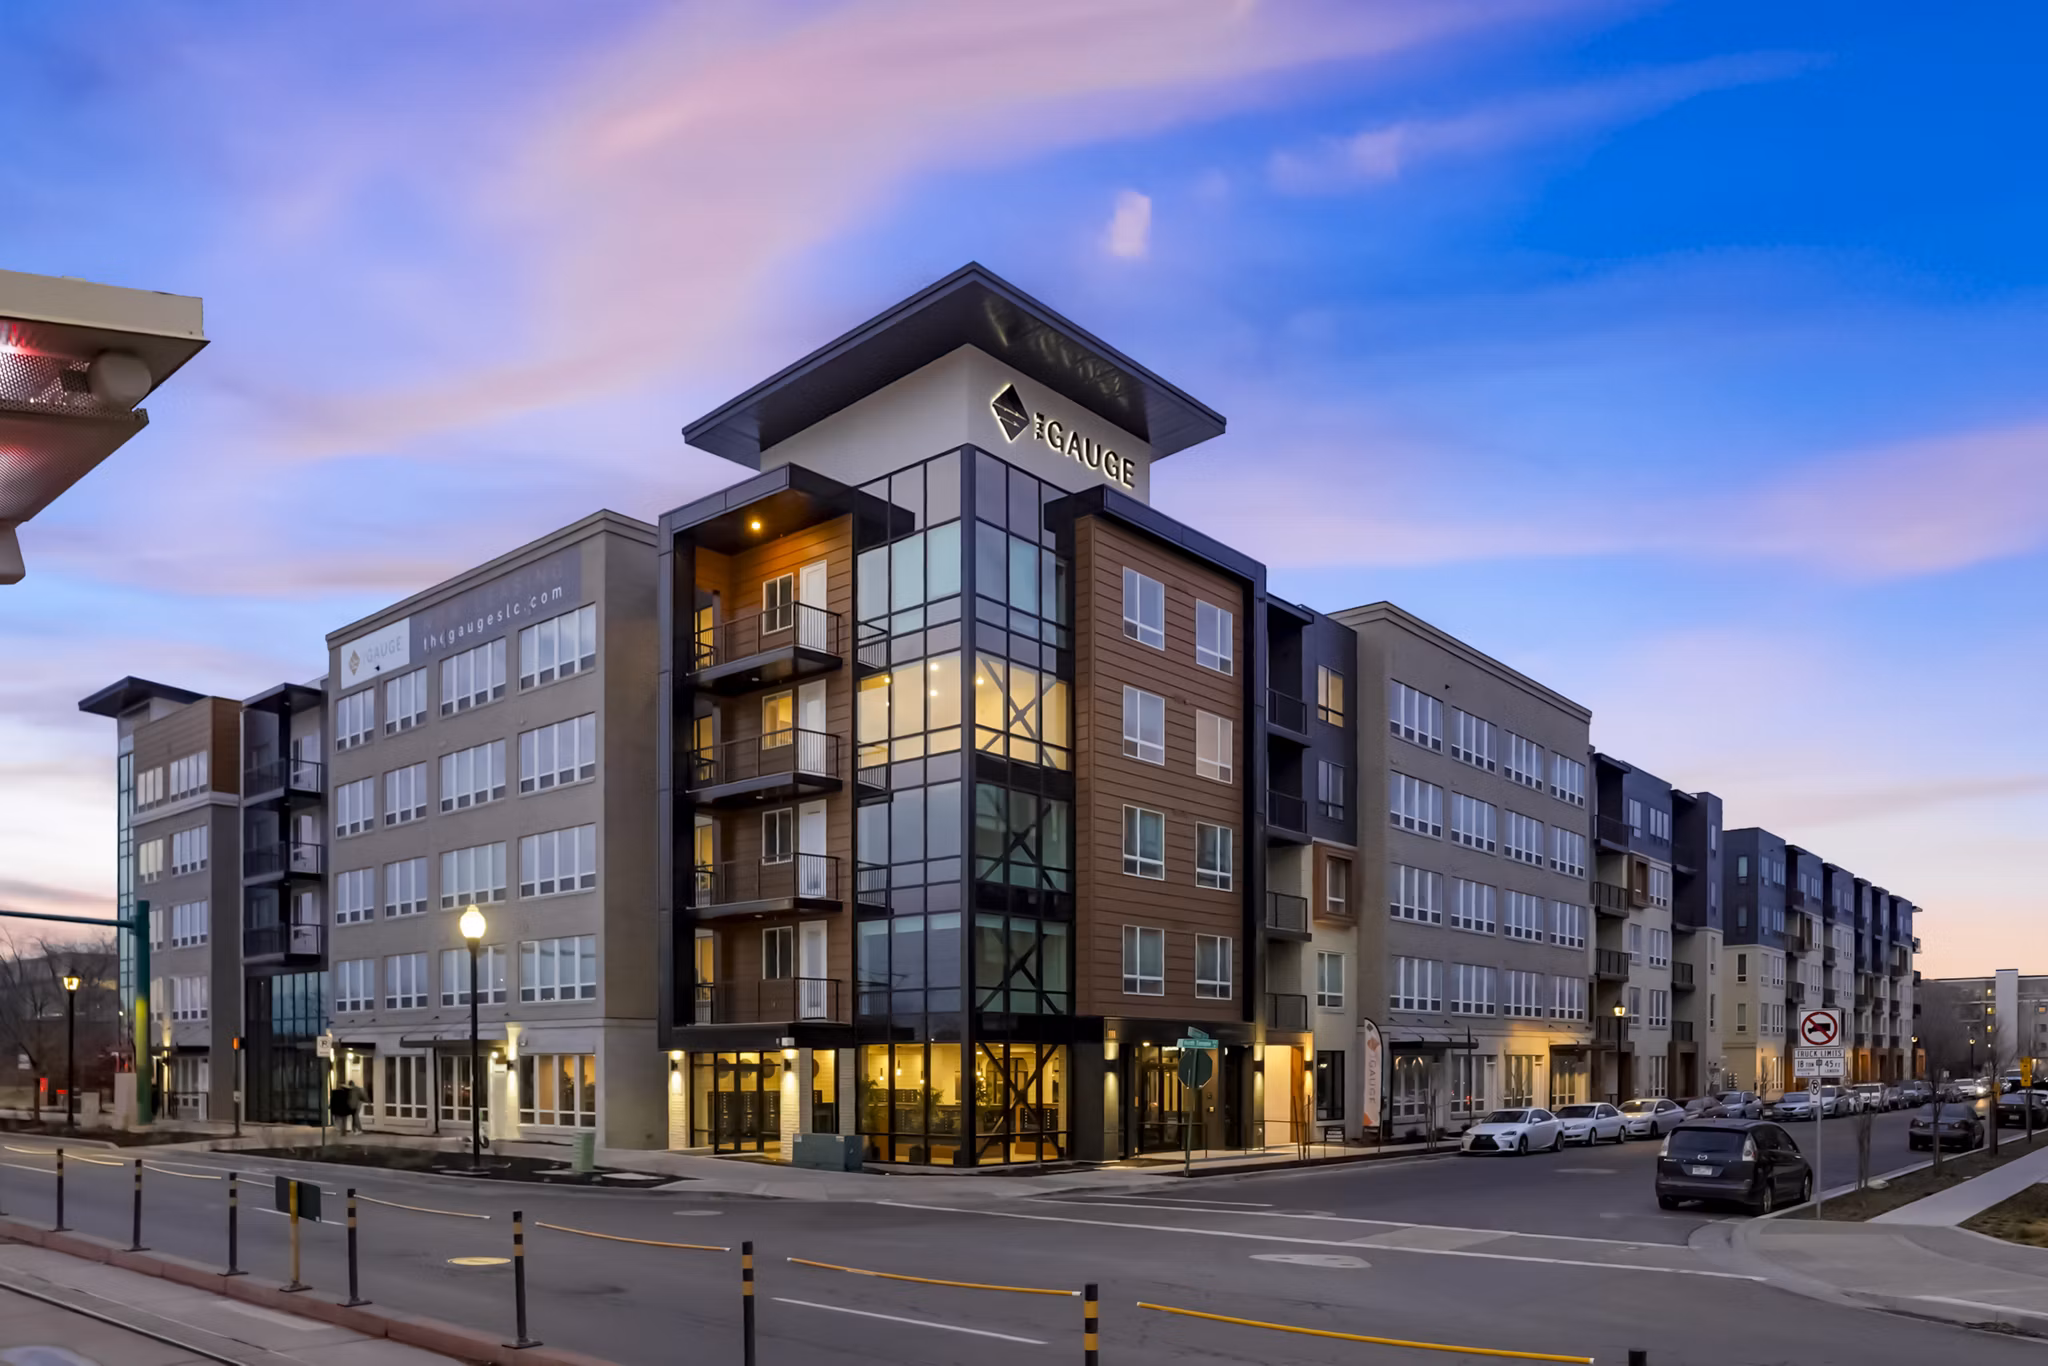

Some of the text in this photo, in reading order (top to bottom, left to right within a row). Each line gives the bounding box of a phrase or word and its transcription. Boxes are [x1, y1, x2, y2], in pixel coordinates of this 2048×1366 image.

[1045, 420, 1136, 489] GAUGE
[366, 636, 402, 662] GAUGE
[1797, 1060, 1804, 1068] 18
[1824, 1060, 1834, 1068] 45
